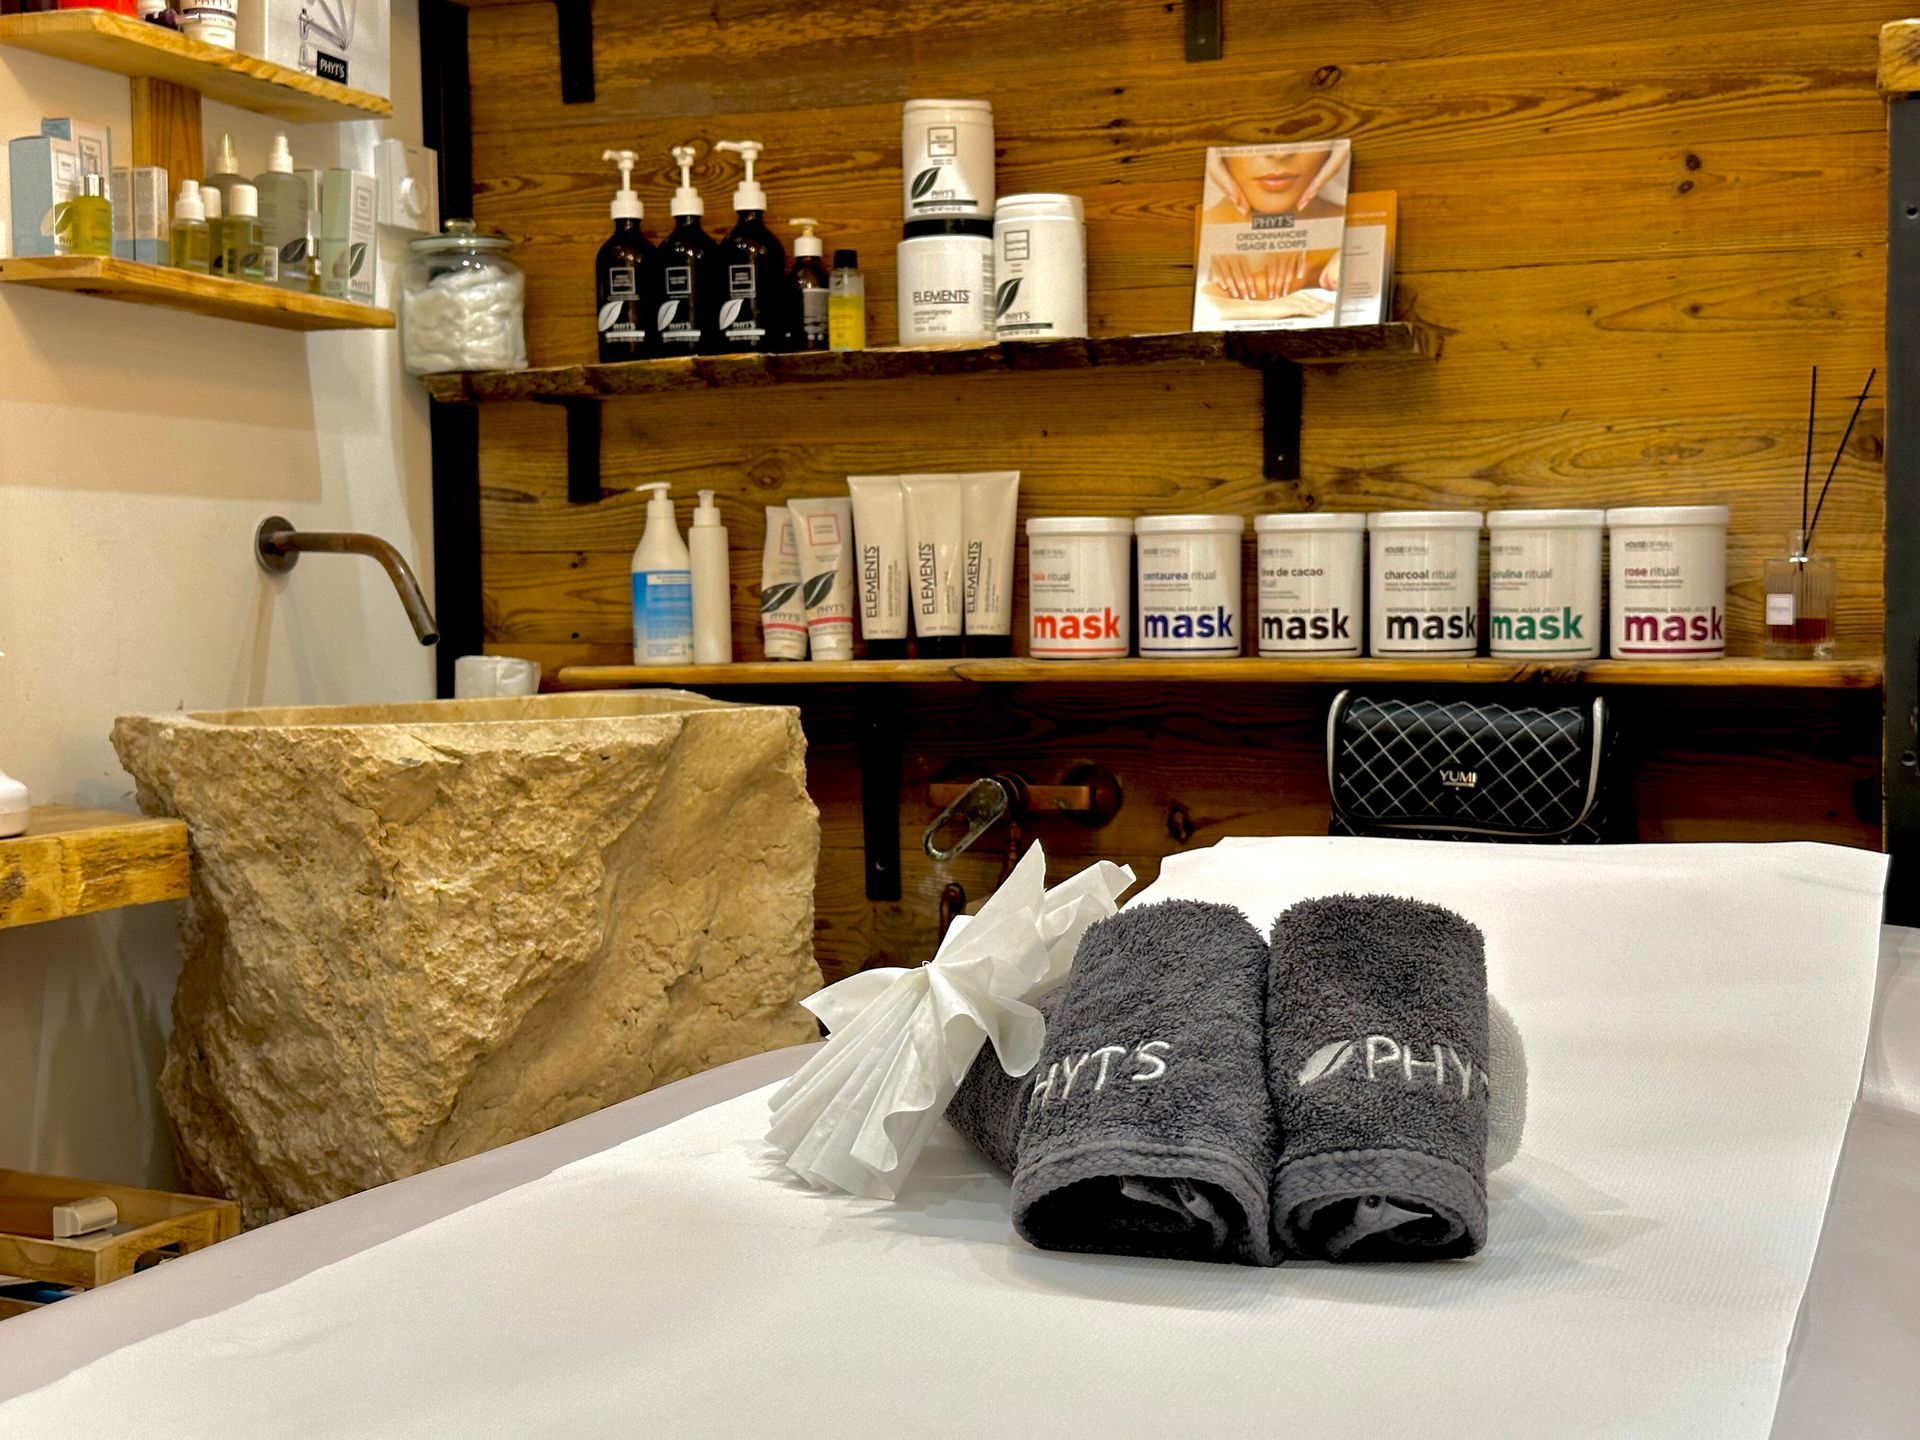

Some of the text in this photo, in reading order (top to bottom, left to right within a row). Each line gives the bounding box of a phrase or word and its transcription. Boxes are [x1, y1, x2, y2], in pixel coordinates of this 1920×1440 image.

[320, 57, 346, 79] PHYT'S
[1252, 214, 1295, 229] PHYT'S
[1276, 239, 1307, 250] CORPS
[913, 289, 970, 303] ELEMENTS
[1004, 311, 1031, 321] PHYT'S
[863, 545, 879, 618] ELEMENTS
[918, 543, 936, 615] ELEMENTS
[966, 542, 981, 614] ELEMENTS
[1191, 569, 1217, 580] ritual
[1276, 566, 1289, 577] de
[1290, 568, 1324, 577] cacao
[1384, 570, 1457, 580] charcoal ritual
[1524, 568, 1552, 579] ritual
[1624, 566, 1680, 577] rose ritual
[1033, 607, 1120, 640] mask
[1144, 605, 1233, 638] mask
[1261, 608, 1349, 640] mask
[1386, 606, 1476, 640] mask
[1491, 606, 1583, 640] mask
[1624, 605, 1723, 641] mask
[1439, 769, 1477, 783] YUMI
[1366, 1034, 1489, 1100] PHY
